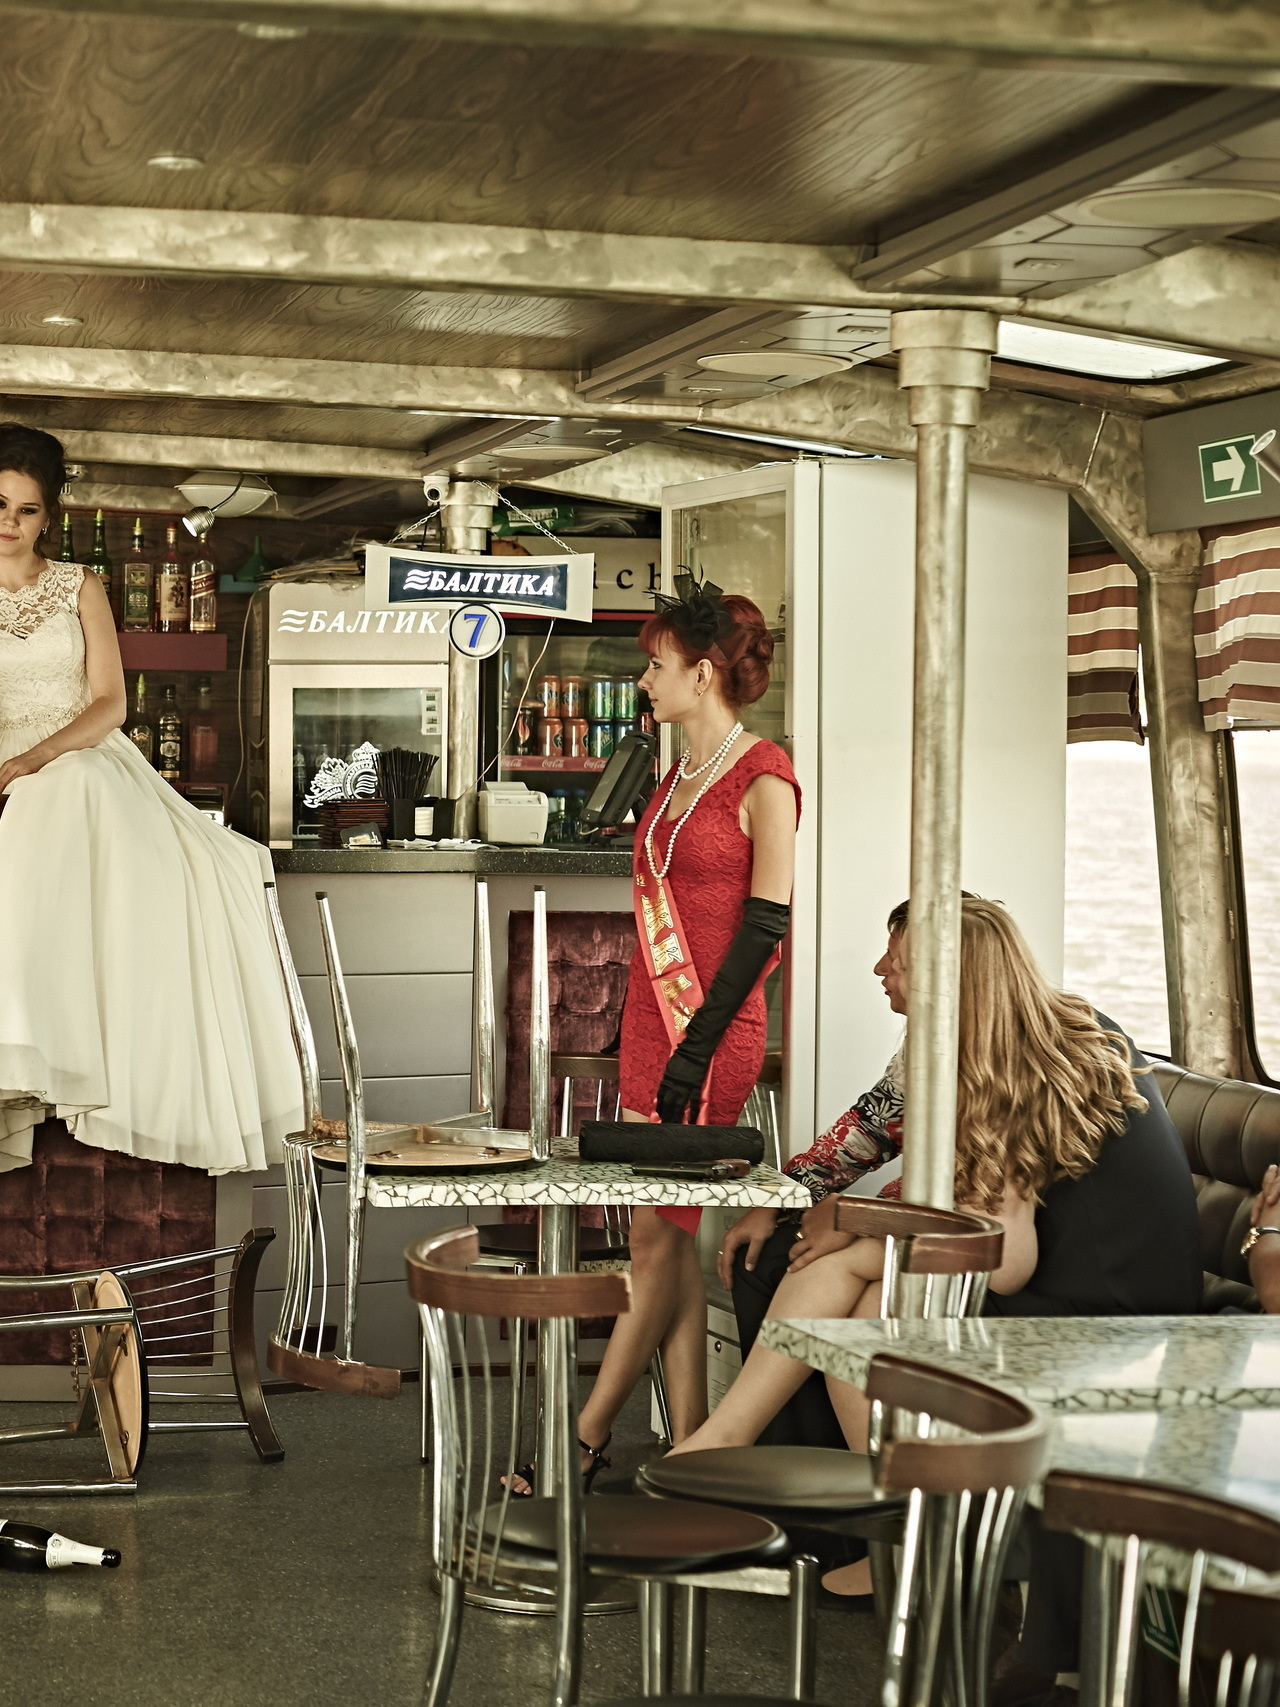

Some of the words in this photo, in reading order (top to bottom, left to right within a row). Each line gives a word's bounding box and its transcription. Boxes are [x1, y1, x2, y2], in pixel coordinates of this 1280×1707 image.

[427, 570, 555, 596] БАЛТИКА
[593, 561, 661, 590] ich
[463, 613, 488, 648] 7
